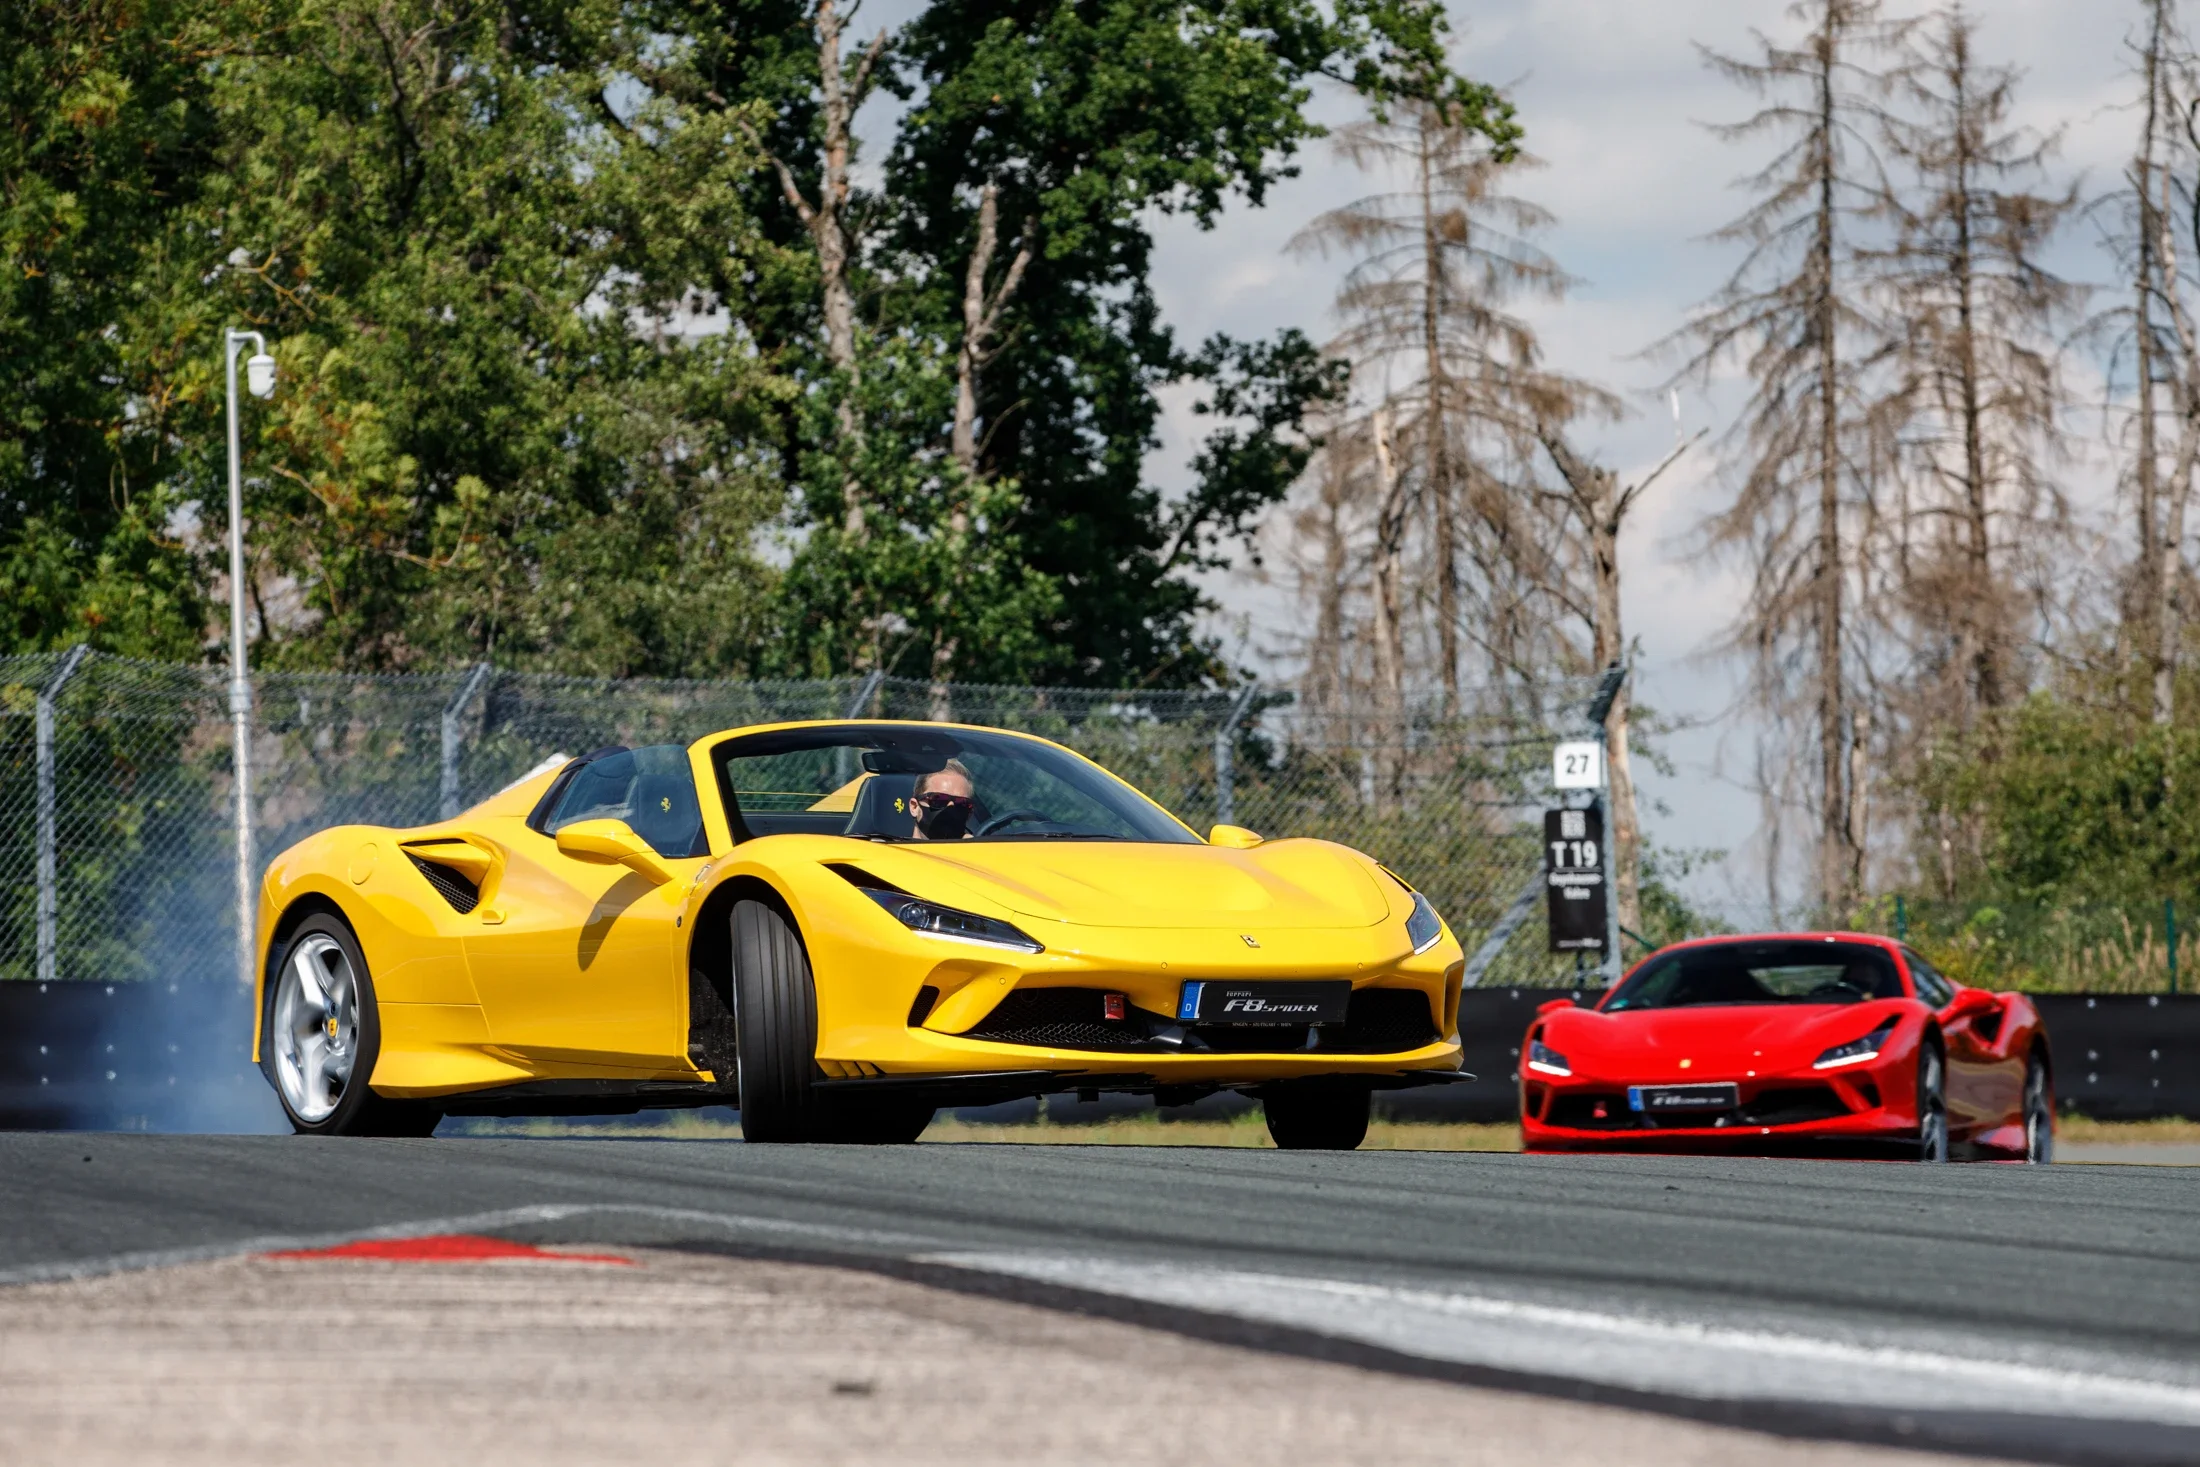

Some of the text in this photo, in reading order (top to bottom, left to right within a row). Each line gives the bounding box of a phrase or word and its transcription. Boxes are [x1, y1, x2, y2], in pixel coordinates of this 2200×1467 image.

[1565, 753, 1589, 774] 27
[1569, 841, 1597, 868] 19
[1185, 1003, 1192, 1012] D
